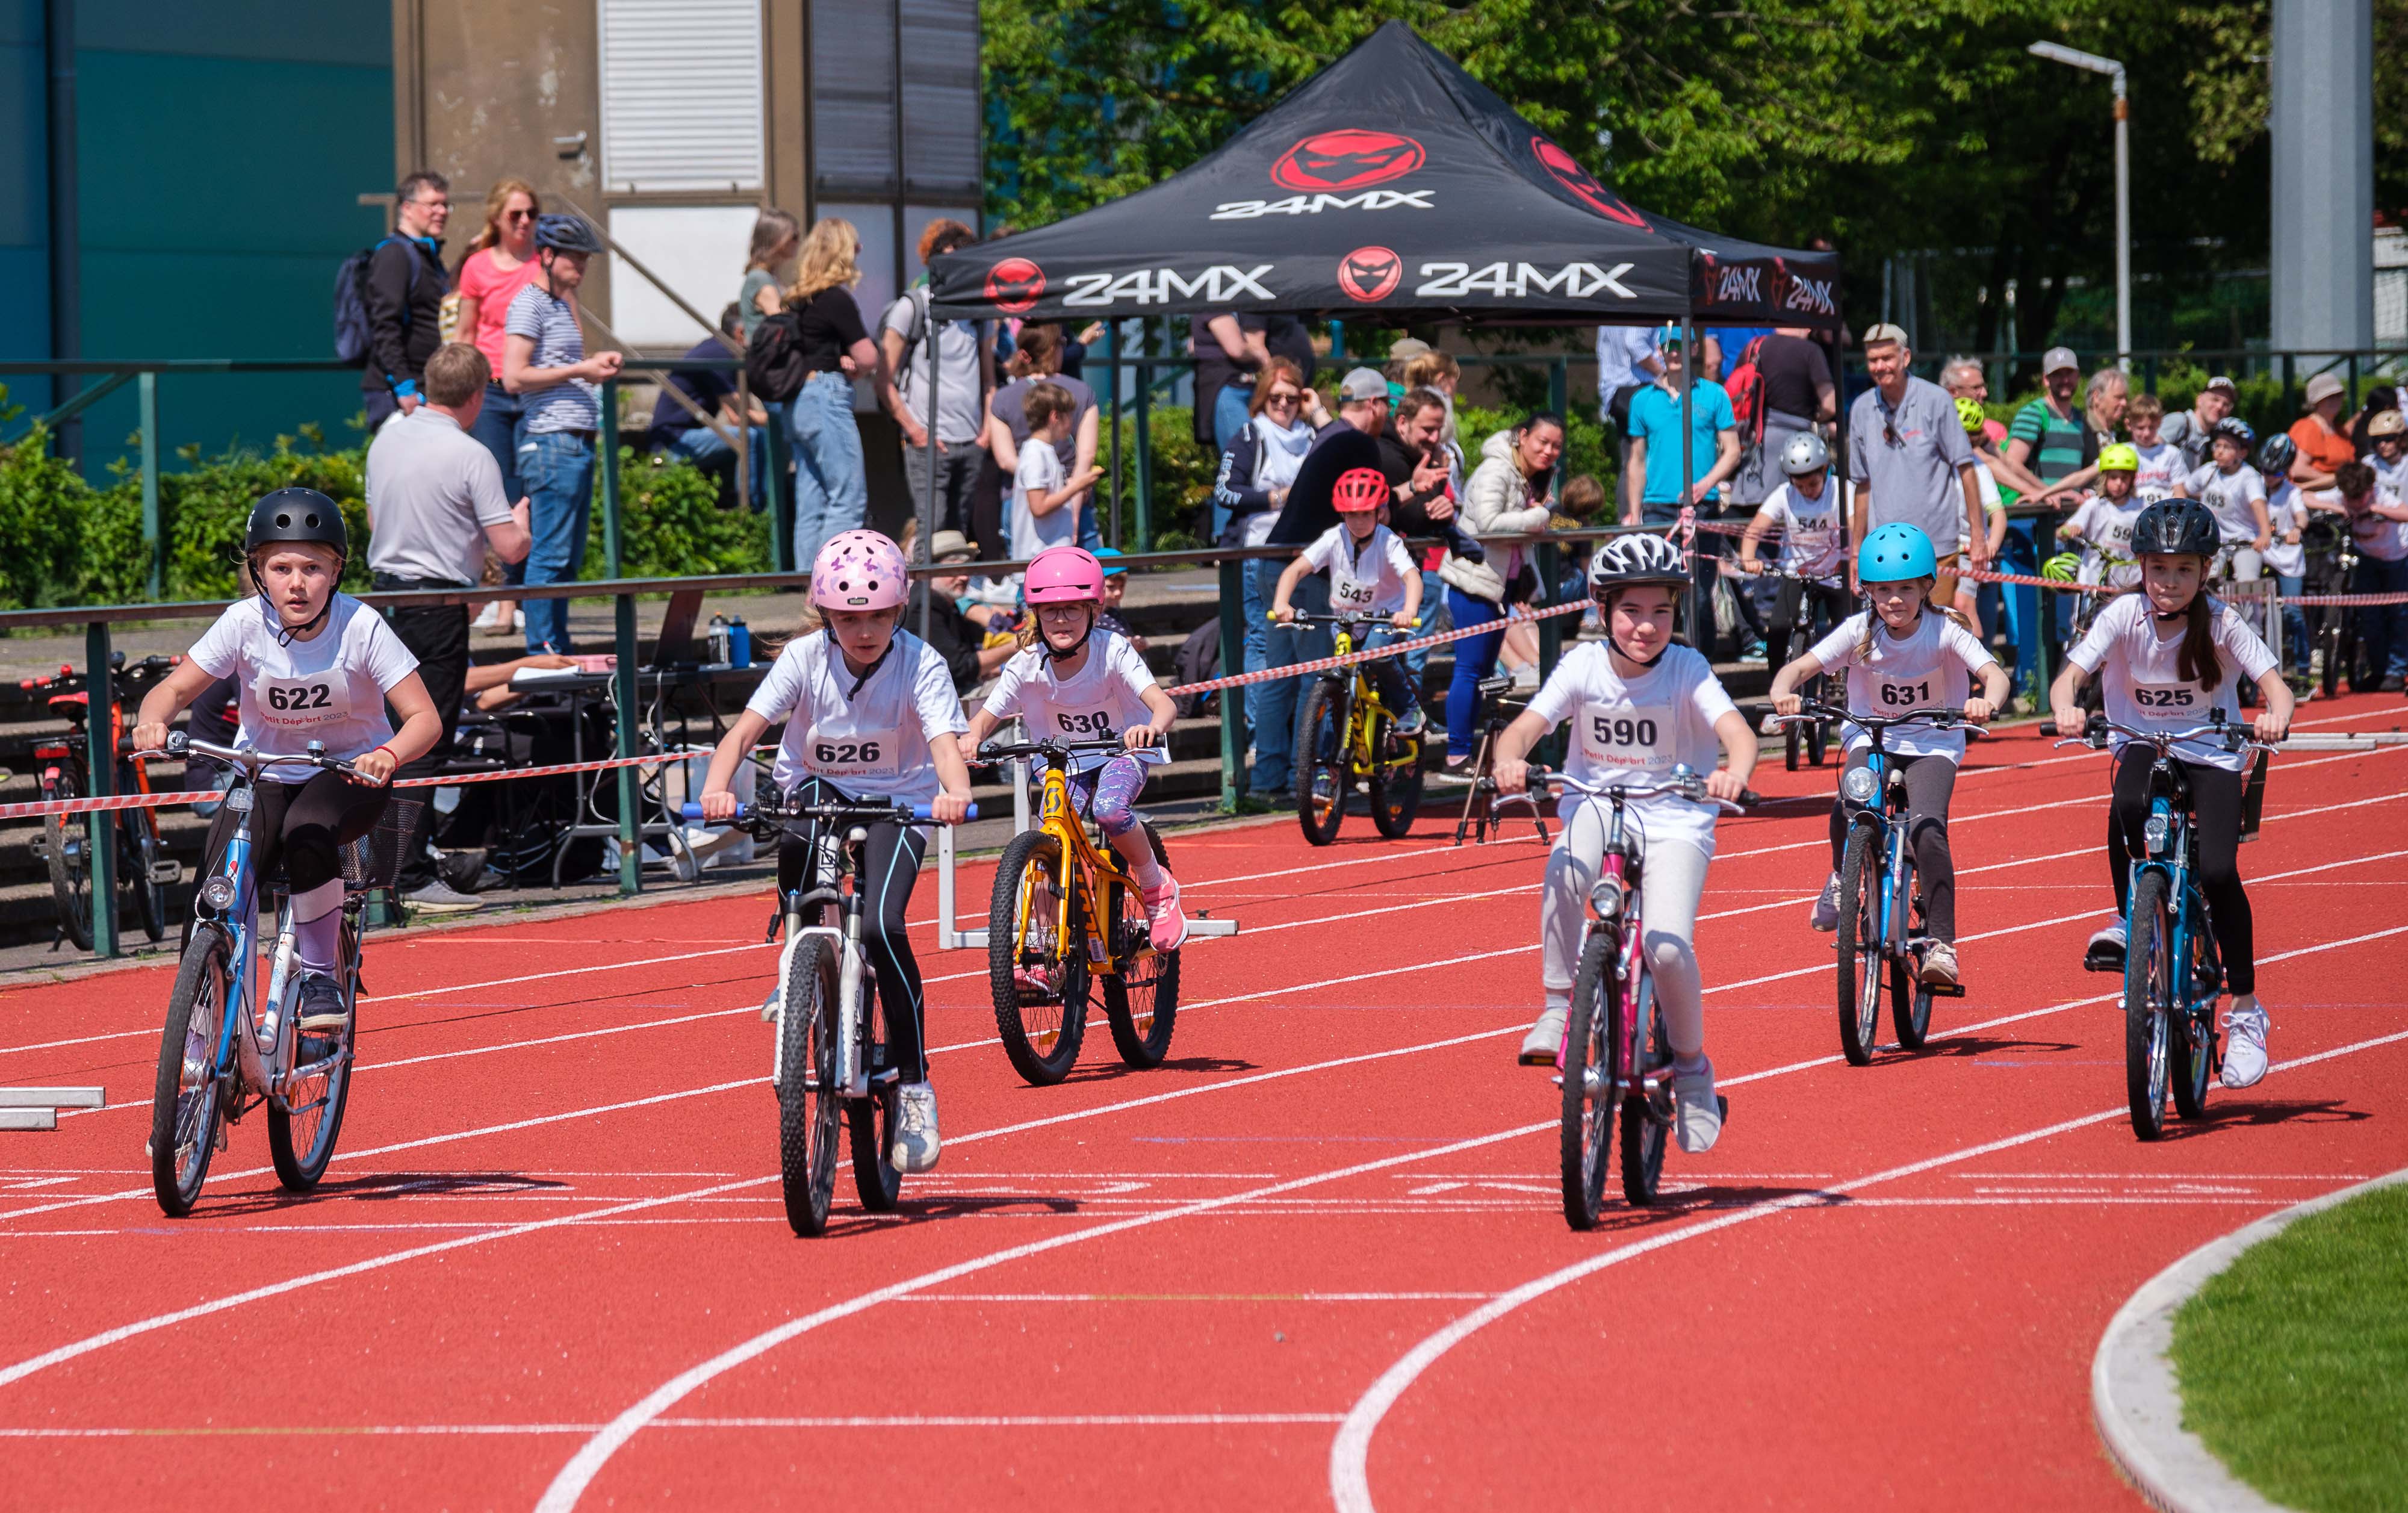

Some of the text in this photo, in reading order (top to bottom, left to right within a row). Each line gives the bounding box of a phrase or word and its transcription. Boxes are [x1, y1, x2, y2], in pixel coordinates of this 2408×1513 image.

[1209, 190, 1435, 220] 24MX
[1063, 264, 1276, 306] 24MX
[1415, 262, 1637, 298] 24MX
[1718, 265, 1761, 302] 24MX
[1785, 275, 1835, 316] 24MX
[2112, 524, 2132, 541] 59
[1340, 582, 1374, 603] 543
[268, 684, 332, 710] 622
[1881, 681, 1930, 706] 631
[2135, 688, 2194, 707] 625
[323, 711, 349, 721] 2023
[1057, 710, 1109, 733] 630
[1593, 716, 1658, 747] 590
[816, 742, 881, 763] 626
[1583, 748, 1604, 762] Petit
[1647, 754, 1673, 765] 2023
[869, 767, 895, 776] 2023
